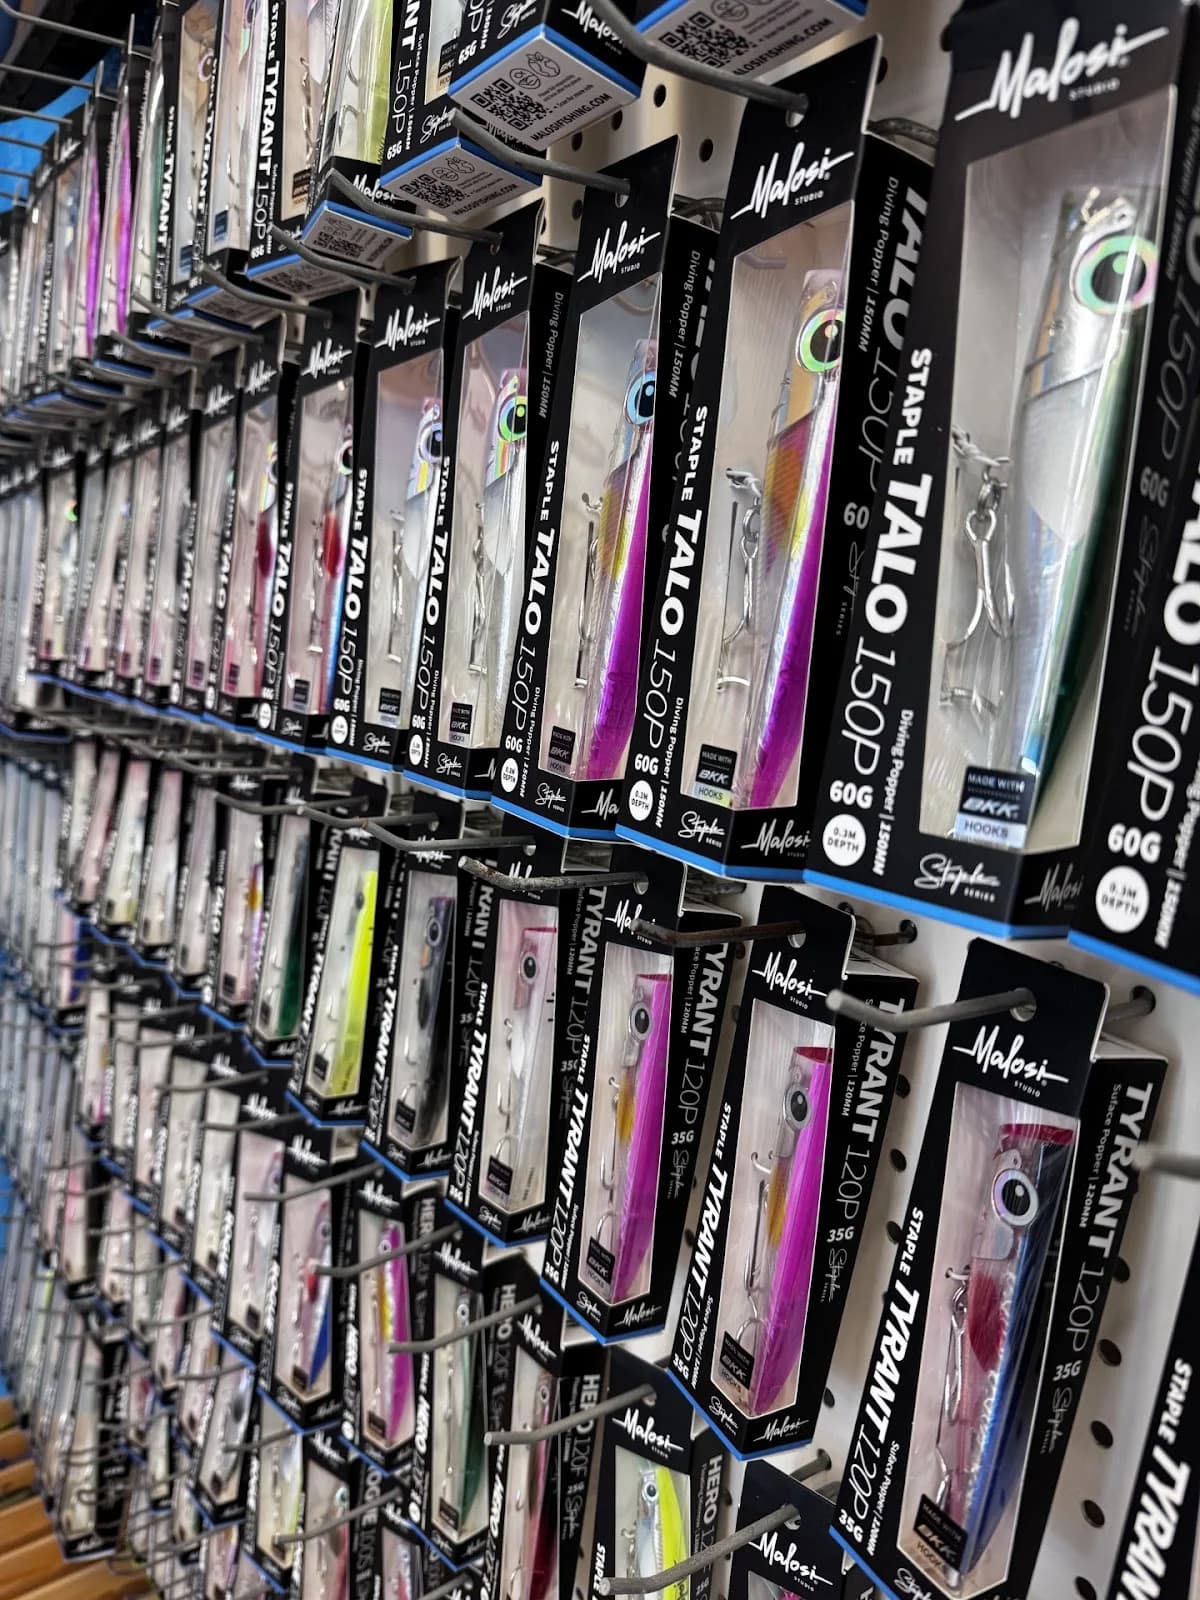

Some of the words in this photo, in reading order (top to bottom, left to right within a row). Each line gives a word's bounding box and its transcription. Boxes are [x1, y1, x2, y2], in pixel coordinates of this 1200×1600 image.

[458, 40, 477, 65] 65G
[733, 16, 834, 76] LOSIFISHING.COM
[955, 17, 1169, 121] Malosi
[391, 60, 412, 134] 150P
[1069, 77, 1120, 99] STUDIO
[259, 61, 280, 176] TYRANT
[530, 92, 613, 141] MALOSIFISHING.COM
[387, 141, 402, 160] 65G
[157, 153, 175, 248] TYRANT
[730, 142, 854, 219] Malosi
[794, 190, 825, 206] STUDIO
[879, 175, 899, 227] Diving
[577, 220, 661, 284] Malosi
[620, 262, 641, 274] STUDIO
[683, 249, 701, 293] Diving
[869, 228, 890, 286] Popper
[462, 266, 528, 321] Malosi
[549, 290, 565, 327] Diving
[374, 304, 441, 351] Malosi
[678, 293, 694, 344] Popper
[857, 295, 877, 352] 150MM
[301, 338, 353, 380] Malosi
[545, 328, 559, 372] Popper
[538, 378, 552, 419] 150MM
[668, 351, 684, 399] 150MM
[893, 348, 933, 466] STAPLE
[681, 405, 708, 502] STAPLE
[353, 469, 368, 531] STAPLE
[436, 455, 451, 527] STAPLE
[540, 440, 560, 521] STAPLE
[1140, 466, 1170, 508] 60G
[344, 535, 369, 620] TALO
[660, 509, 703, 636] TALO
[865, 473, 933, 634] TALO
[271, 542, 293, 617] TALO
[426, 531, 449, 626] TALO
[525, 528, 556, 636] TALO
[264, 617, 282, 684] 150P
[337, 620, 358, 695] 150P
[416, 627, 436, 710] 150P
[333, 698, 351, 713] 60G
[512, 637, 536, 731] 150P
[529, 686, 541, 719] Diving
[643, 638, 677, 749] 150P
[841, 635, 896, 776] 150P
[412, 714, 426, 731] 60G
[526, 719, 536, 757] Popper
[669, 696, 685, 735] Diving
[891, 708, 915, 756] Diving
[1127, 645, 1200, 821] 150P
[505, 735, 524, 754] 60G
[634, 752, 660, 775] 60G
[663, 735, 678, 780] Popper
[701, 750, 717, 761] MADE
[717, 753, 733, 764] WITH
[519, 762, 530, 798] 150MM
[698, 769, 729, 785] BKK
[698, 786, 724, 801] HOOKS
[830, 779, 875, 810] 60G
[882, 753, 905, 812] Popper
[968, 772, 996, 787] MADE
[997, 776, 1026, 792] WITH
[631, 798, 650, 811] DEPTH
[655, 785, 668, 829] 150MM
[678, 811, 725, 842] Staple
[961, 797, 1020, 819] BKK
[740, 817, 811, 857] Malosi
[827, 836, 860, 853] DEPTH
[872, 818, 893, 876] 150MM
[963, 820, 1010, 839] HOOKS
[1108, 823, 1163, 864] 60G
[914, 852, 1001, 895] Staple
[964, 886, 996, 903] SERIES
[1024, 862, 1086, 913] Malosi
[574, 885, 608, 996] TYRANT
[687, 963, 700, 1000] Popper
[752, 951, 827, 997] Malosi
[475, 982, 488, 1027] STAPLE
[680, 1001, 692, 1034] 120MM
[789, 995, 808, 1010] STUDIO
[374, 986, 398, 1082] TYRANT
[849, 1030, 866, 1073] Popper
[952, 1025, 1069, 1083] Malosi
[460, 1029, 487, 1135] TYRANT
[577, 1033, 591, 1085] STAPLE
[678, 1057, 706, 1125] 120P
[841, 1079, 856, 1118] 120MM
[1013, 1079, 1041, 1098] STUDIO
[559, 1087, 589, 1209] TYRANT
[671, 1129, 695, 1146] 35G
[715, 1101, 732, 1161] STAPLE
[1091, 1128, 1111, 1178] Popper
[453, 1127, 471, 1189] 120P
[835, 1144, 871, 1220] 120P
[1087, 1082, 1154, 1259] TYRANT
[1079, 1182, 1097, 1228] 120MM
[550, 1197, 569, 1266] 120P
[692, 1162, 728, 1299] TYRANT
[826, 1225, 855, 1244] 35G
[899, 1206, 925, 1276] STAPLE
[679, 1283, 701, 1361] 120P
[1066, 1261, 1104, 1353] 120P
[672, 1352, 690, 1380] 35G
[721, 1354, 747, 1381] BKK
[721, 1369, 742, 1393] HOOKS
[865, 1279, 920, 1444] TYRANT
[1052, 1359, 1082, 1382] 35G
[1157, 1357, 1193, 1444] STAPLE
[612, 1407, 684, 1452] Malosi
[753, 1415, 809, 1442] Malosi
[703, 1454, 723, 1525] HERO
[848, 1424, 881, 1520] 120P
[876, 1474, 891, 1514] Popper
[838, 1508, 864, 1543] 35G
[916, 1523, 960, 1561] BKK
[748, 1531, 834, 1586] Malosi
[794, 1576, 815, 1592] STUDIO
